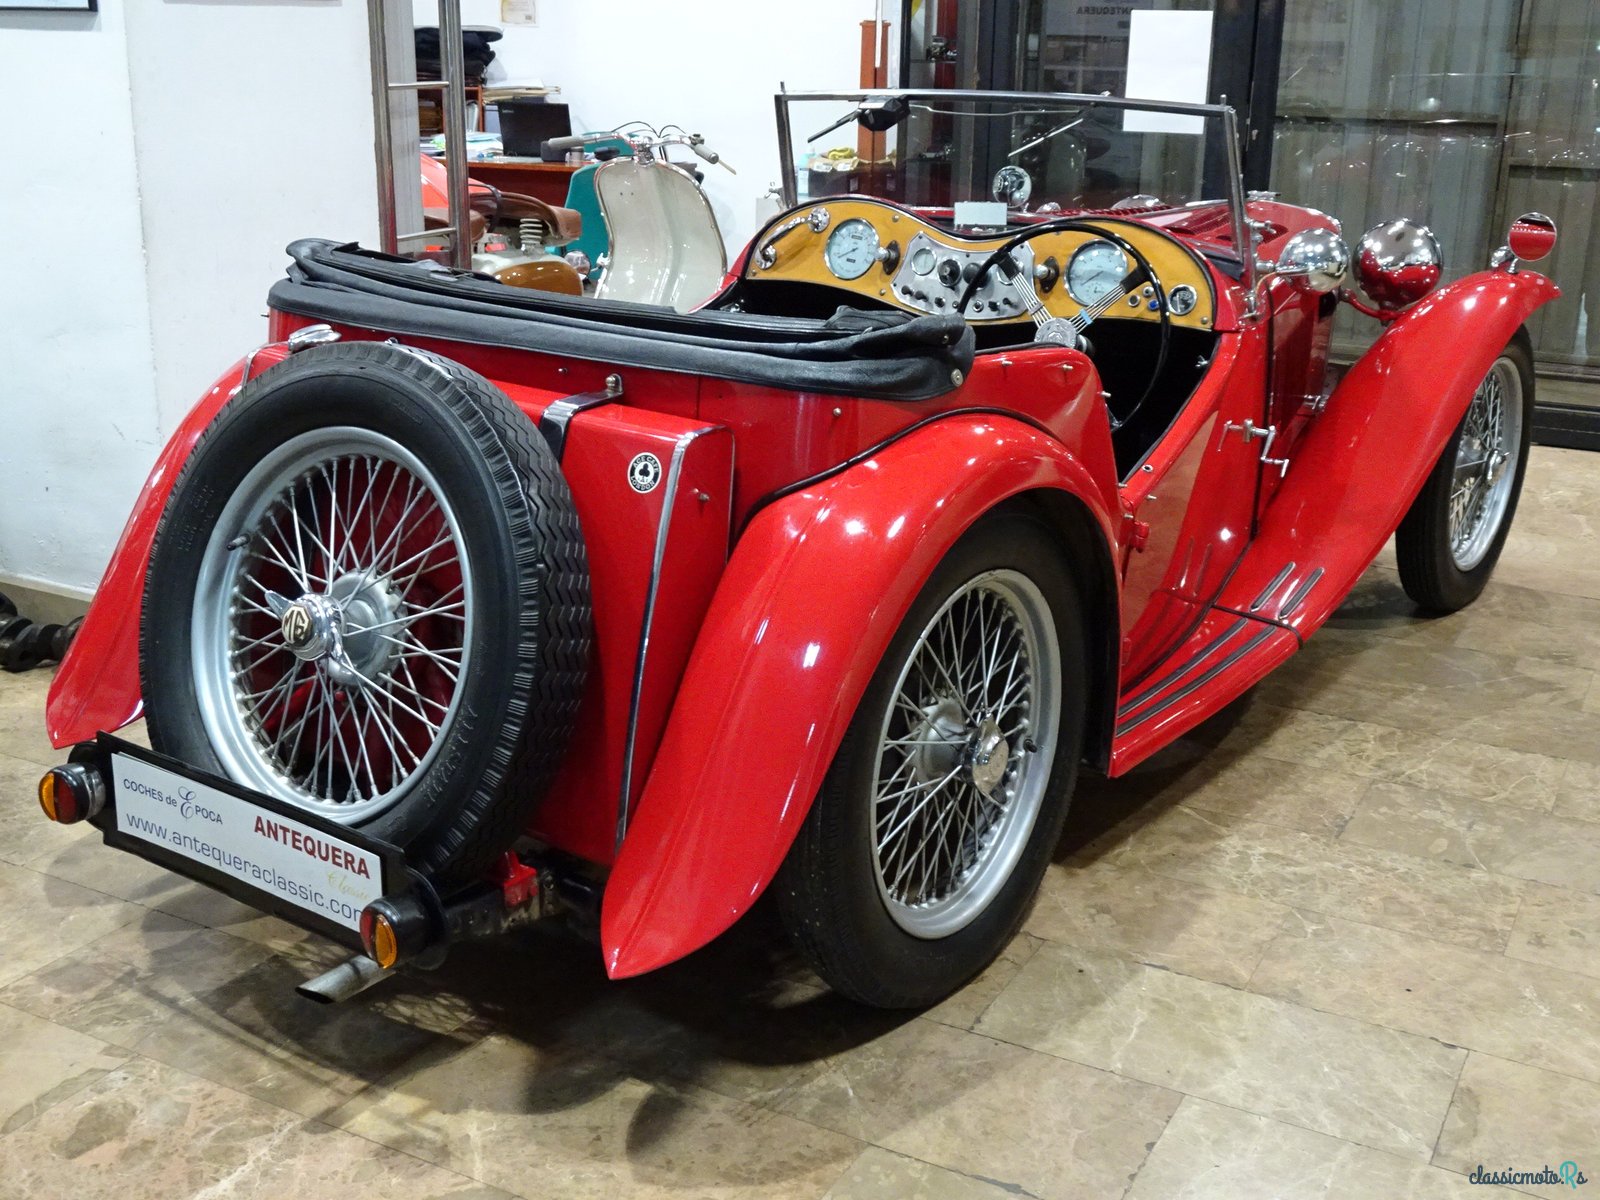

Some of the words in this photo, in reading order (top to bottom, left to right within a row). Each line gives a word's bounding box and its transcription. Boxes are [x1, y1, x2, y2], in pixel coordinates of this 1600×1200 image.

[632, 455, 646, 468] ACE
[630, 475, 655, 491] LONDON
[283, 607, 309, 643] MG
[123, 778, 164, 802] COCHES
[165, 795, 178, 807] de
[254, 815, 371, 880] ANTEQUERA
